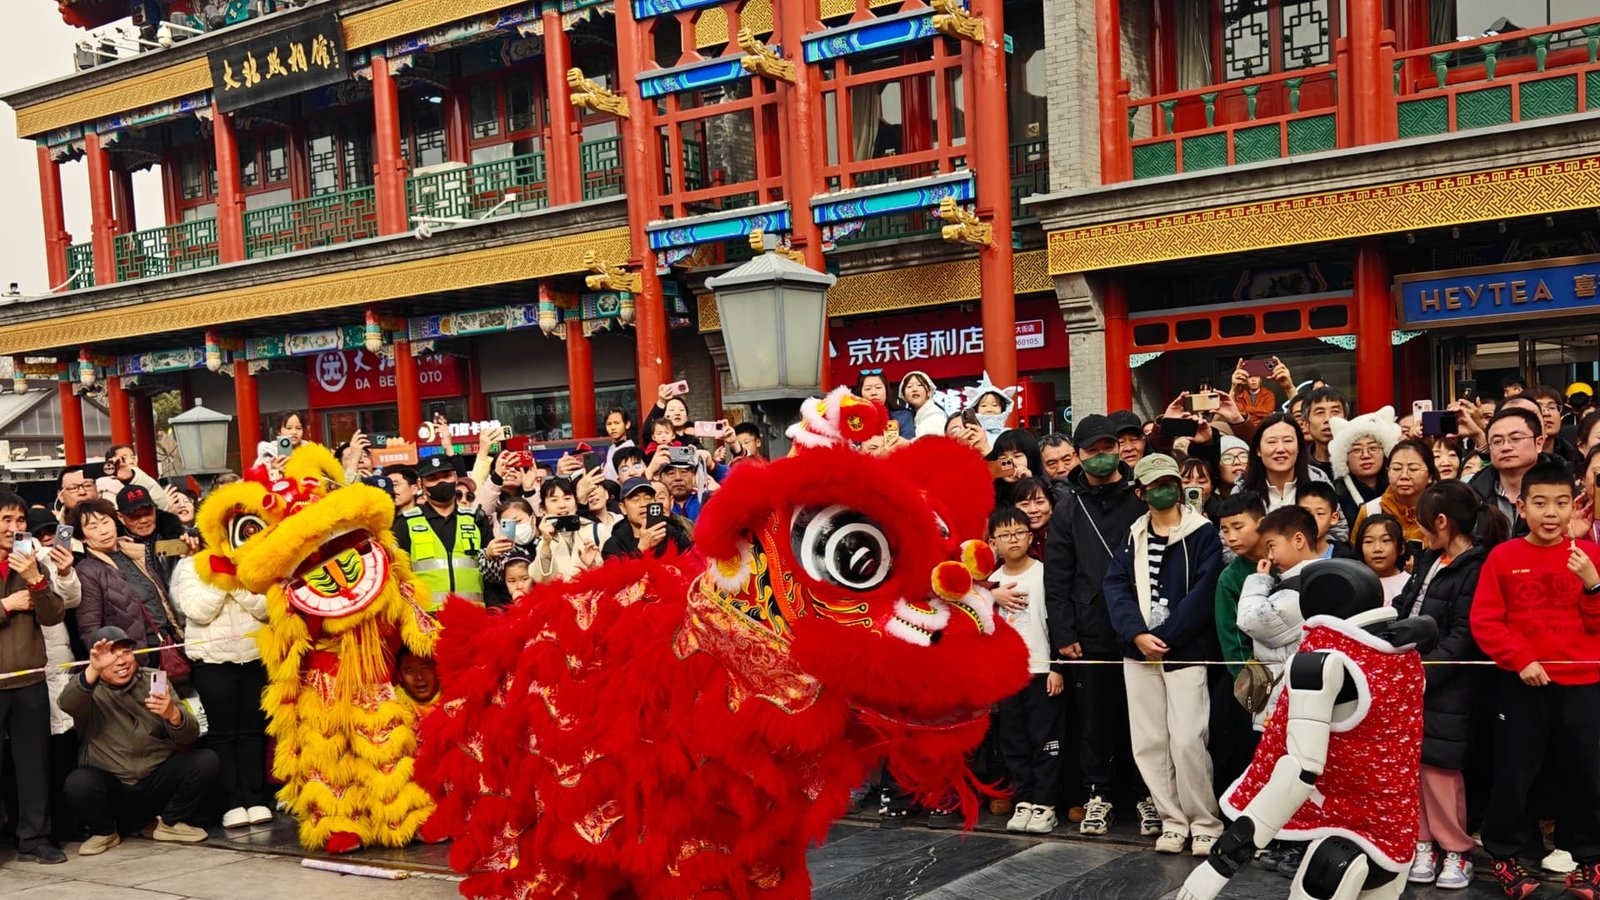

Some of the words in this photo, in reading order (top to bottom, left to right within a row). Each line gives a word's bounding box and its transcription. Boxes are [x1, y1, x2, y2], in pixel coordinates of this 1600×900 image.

[1420, 278, 1554, 312] HEYTEA
[1573, 274, 1600, 298] 喜
[847, 325, 984, 366] 京东便利店
[355, 377, 371, 390] DA
[420, 370, 442, 384] OTO
